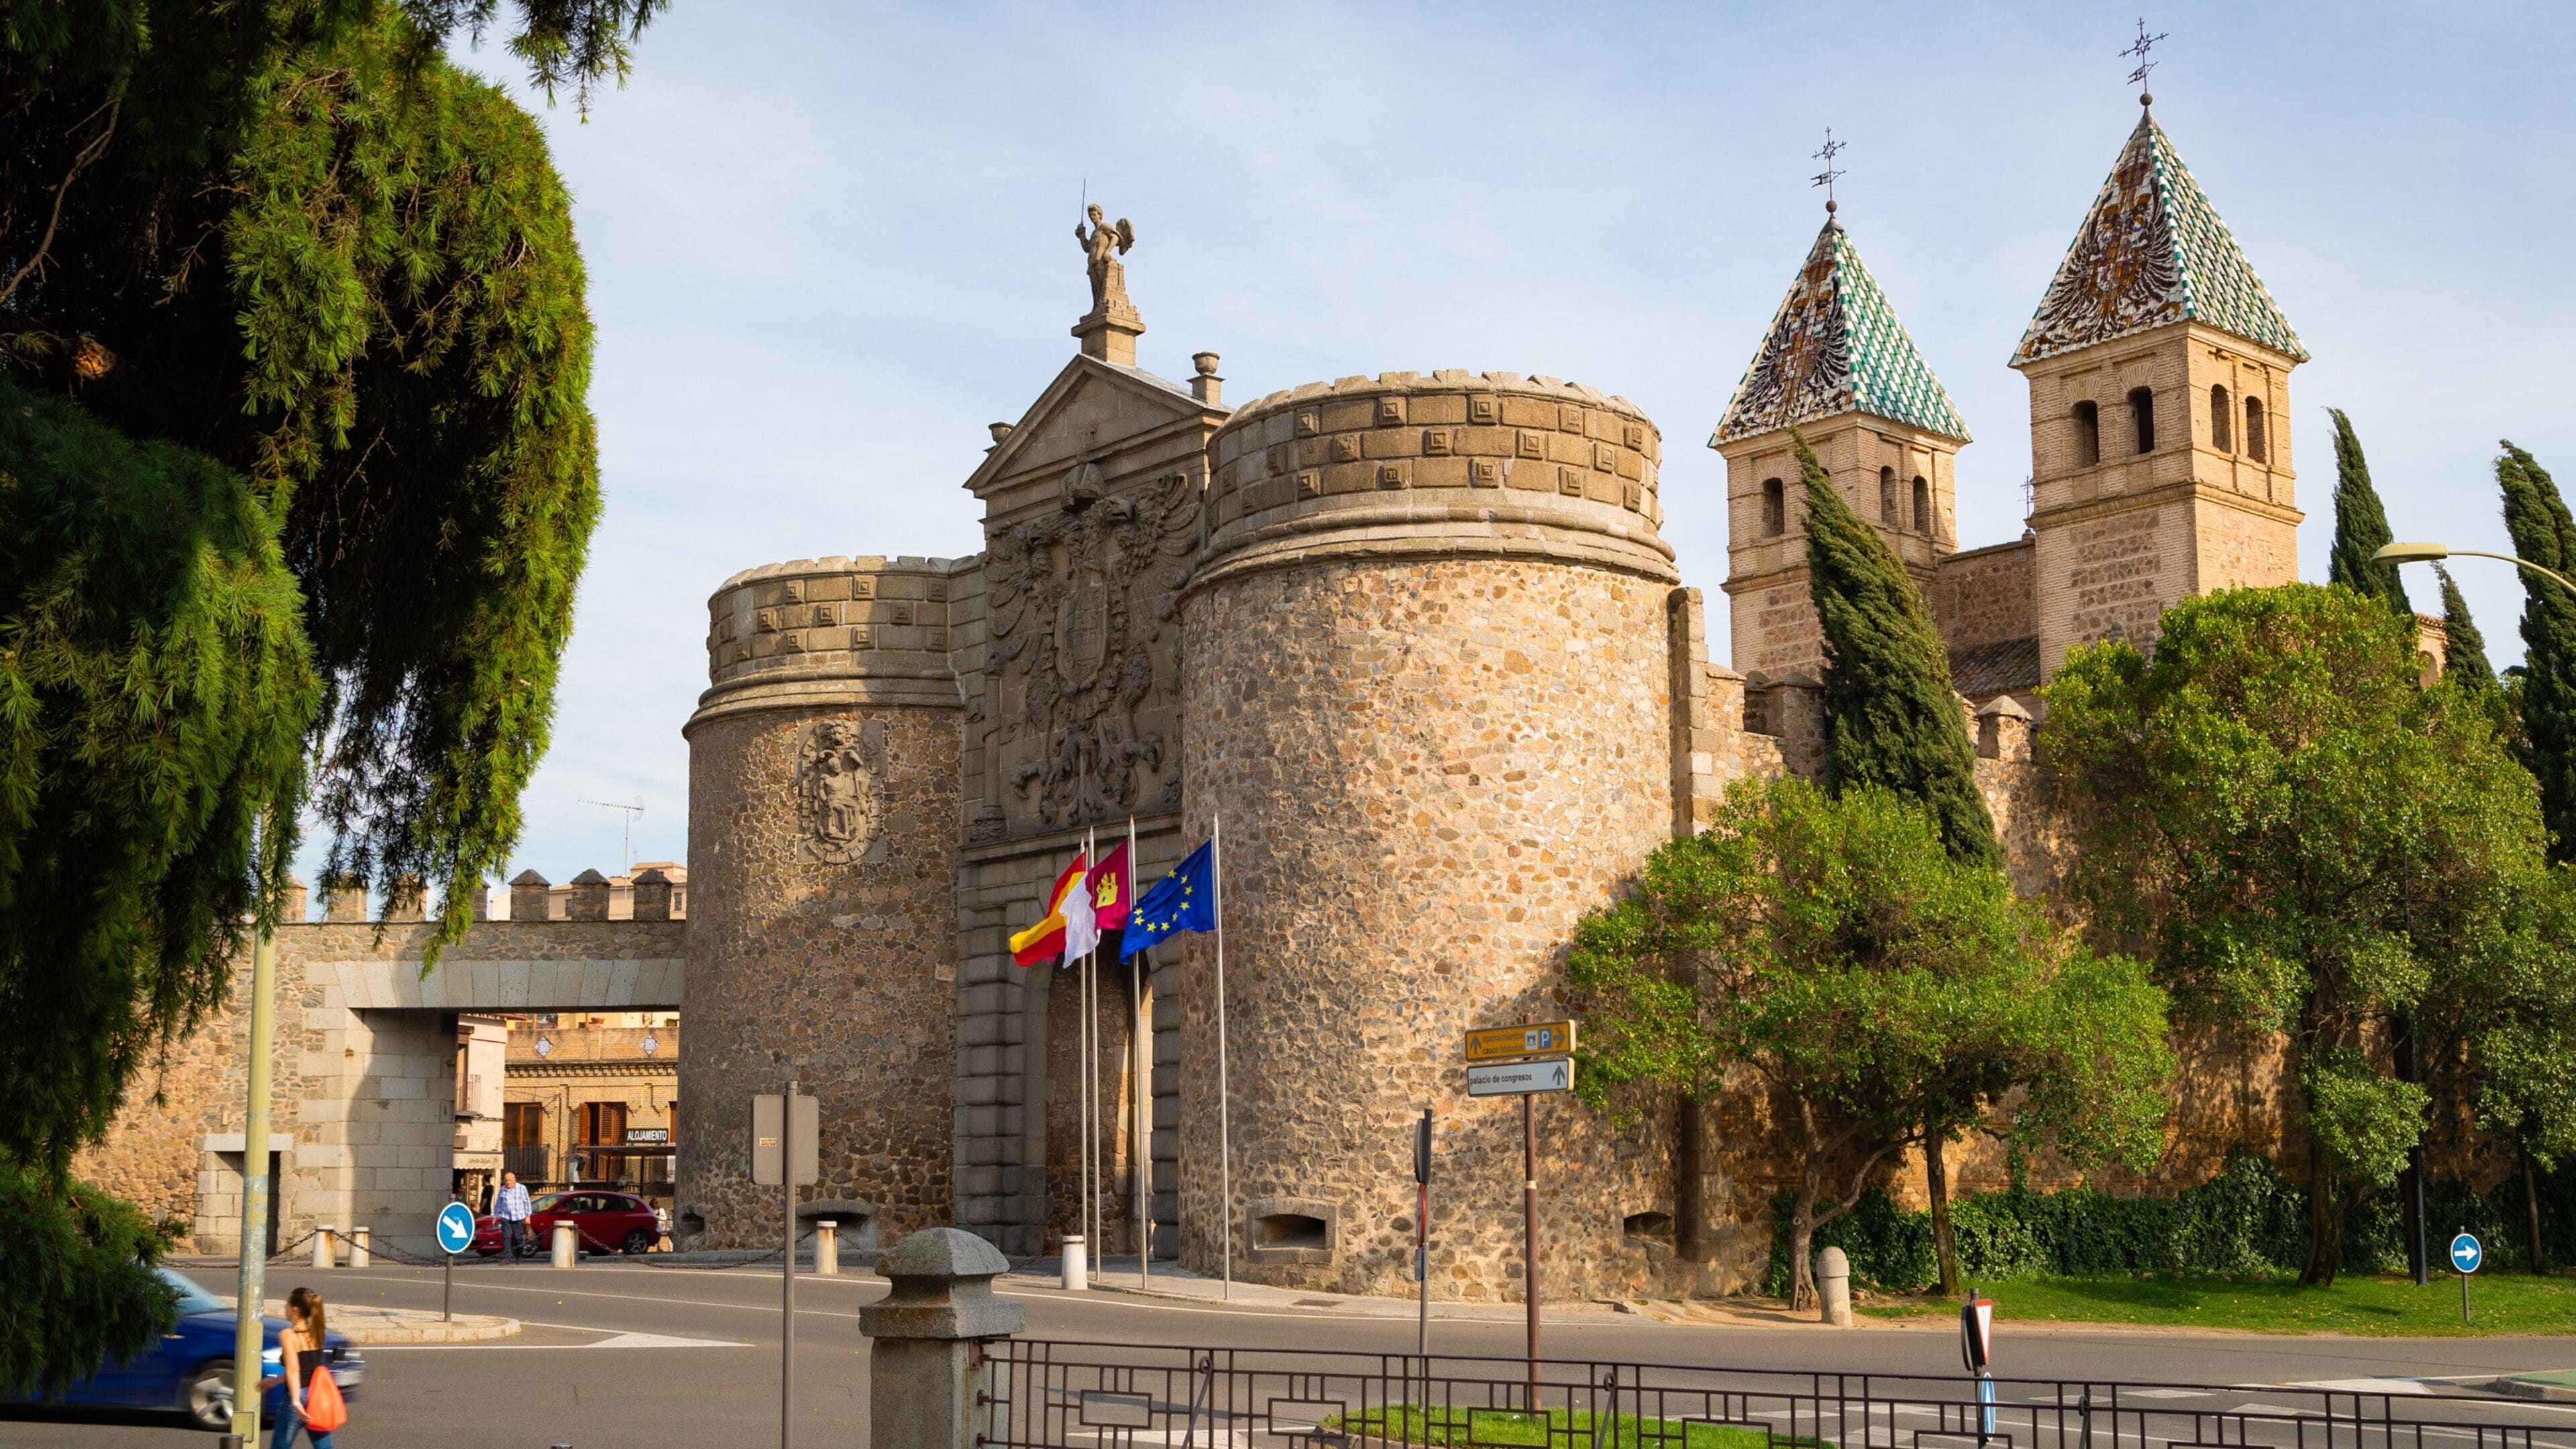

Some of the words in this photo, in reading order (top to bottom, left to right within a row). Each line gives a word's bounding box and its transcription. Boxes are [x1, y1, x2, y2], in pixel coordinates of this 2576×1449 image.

[1483, 1032, 1523, 1044] aparcamientos
[1541, 1030, 1549, 1047] P
[1470, 1075, 1491, 1086] palacio
[1493, 1074, 1500, 1083] de
[1501, 1073, 1532, 1083] congresos
[627, 1130, 667, 1140] ALOJAMIENTO
